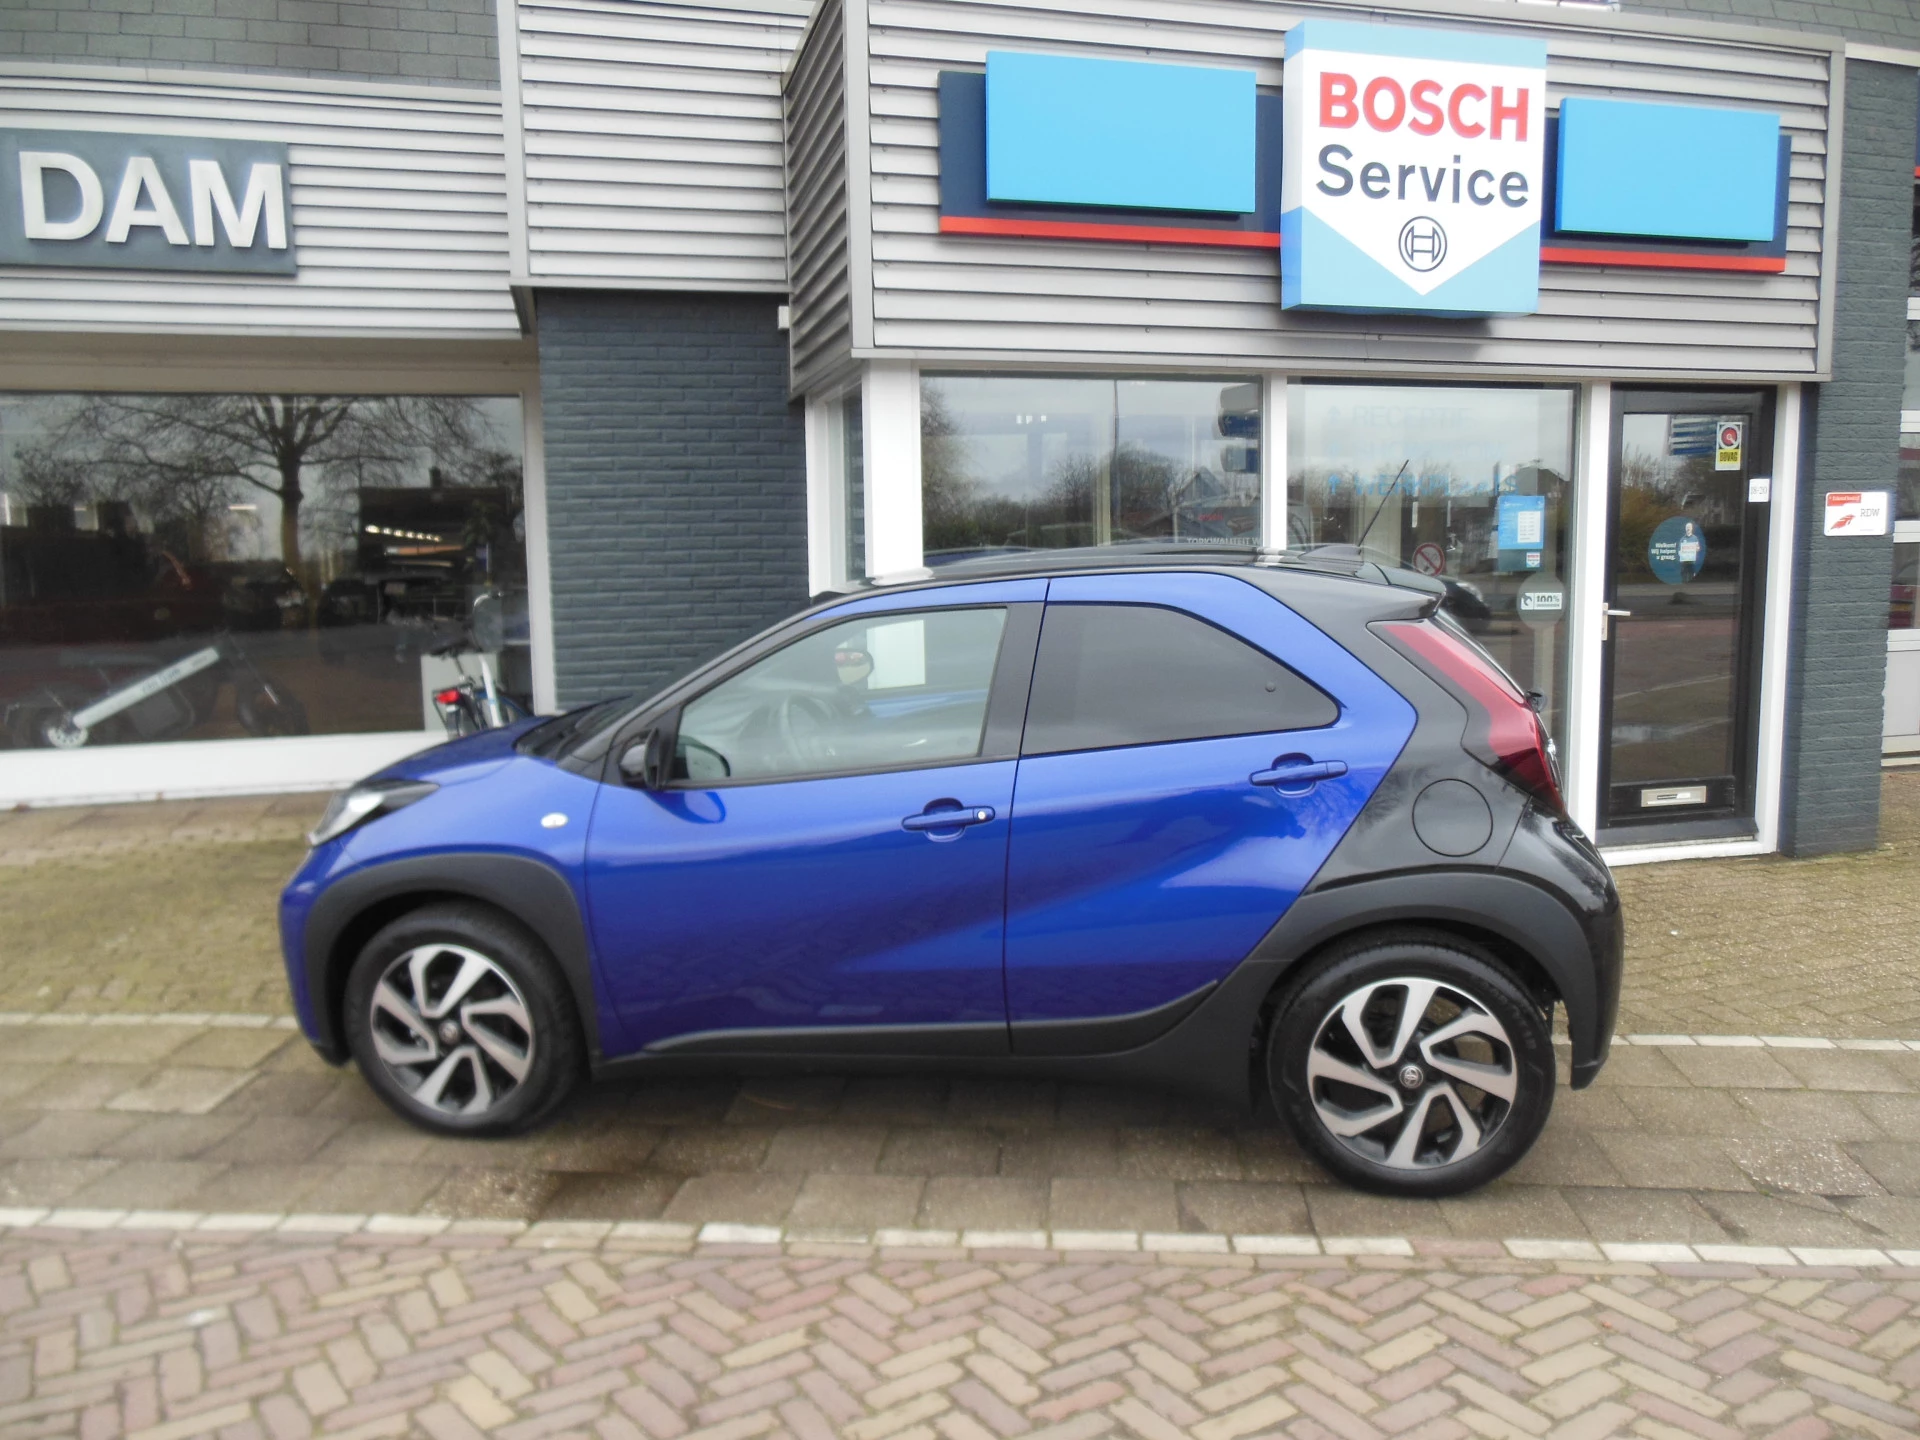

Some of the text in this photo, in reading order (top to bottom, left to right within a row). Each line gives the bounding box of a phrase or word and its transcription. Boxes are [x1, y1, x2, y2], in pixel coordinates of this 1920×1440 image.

[1319, 71, 1530, 142] BOSCH
[19, 151, 287, 249] DAM
[1316, 144, 1529, 208] Service
[1720, 451, 1738, 462] BOVAG
[1860, 508, 1880, 517] RDW
